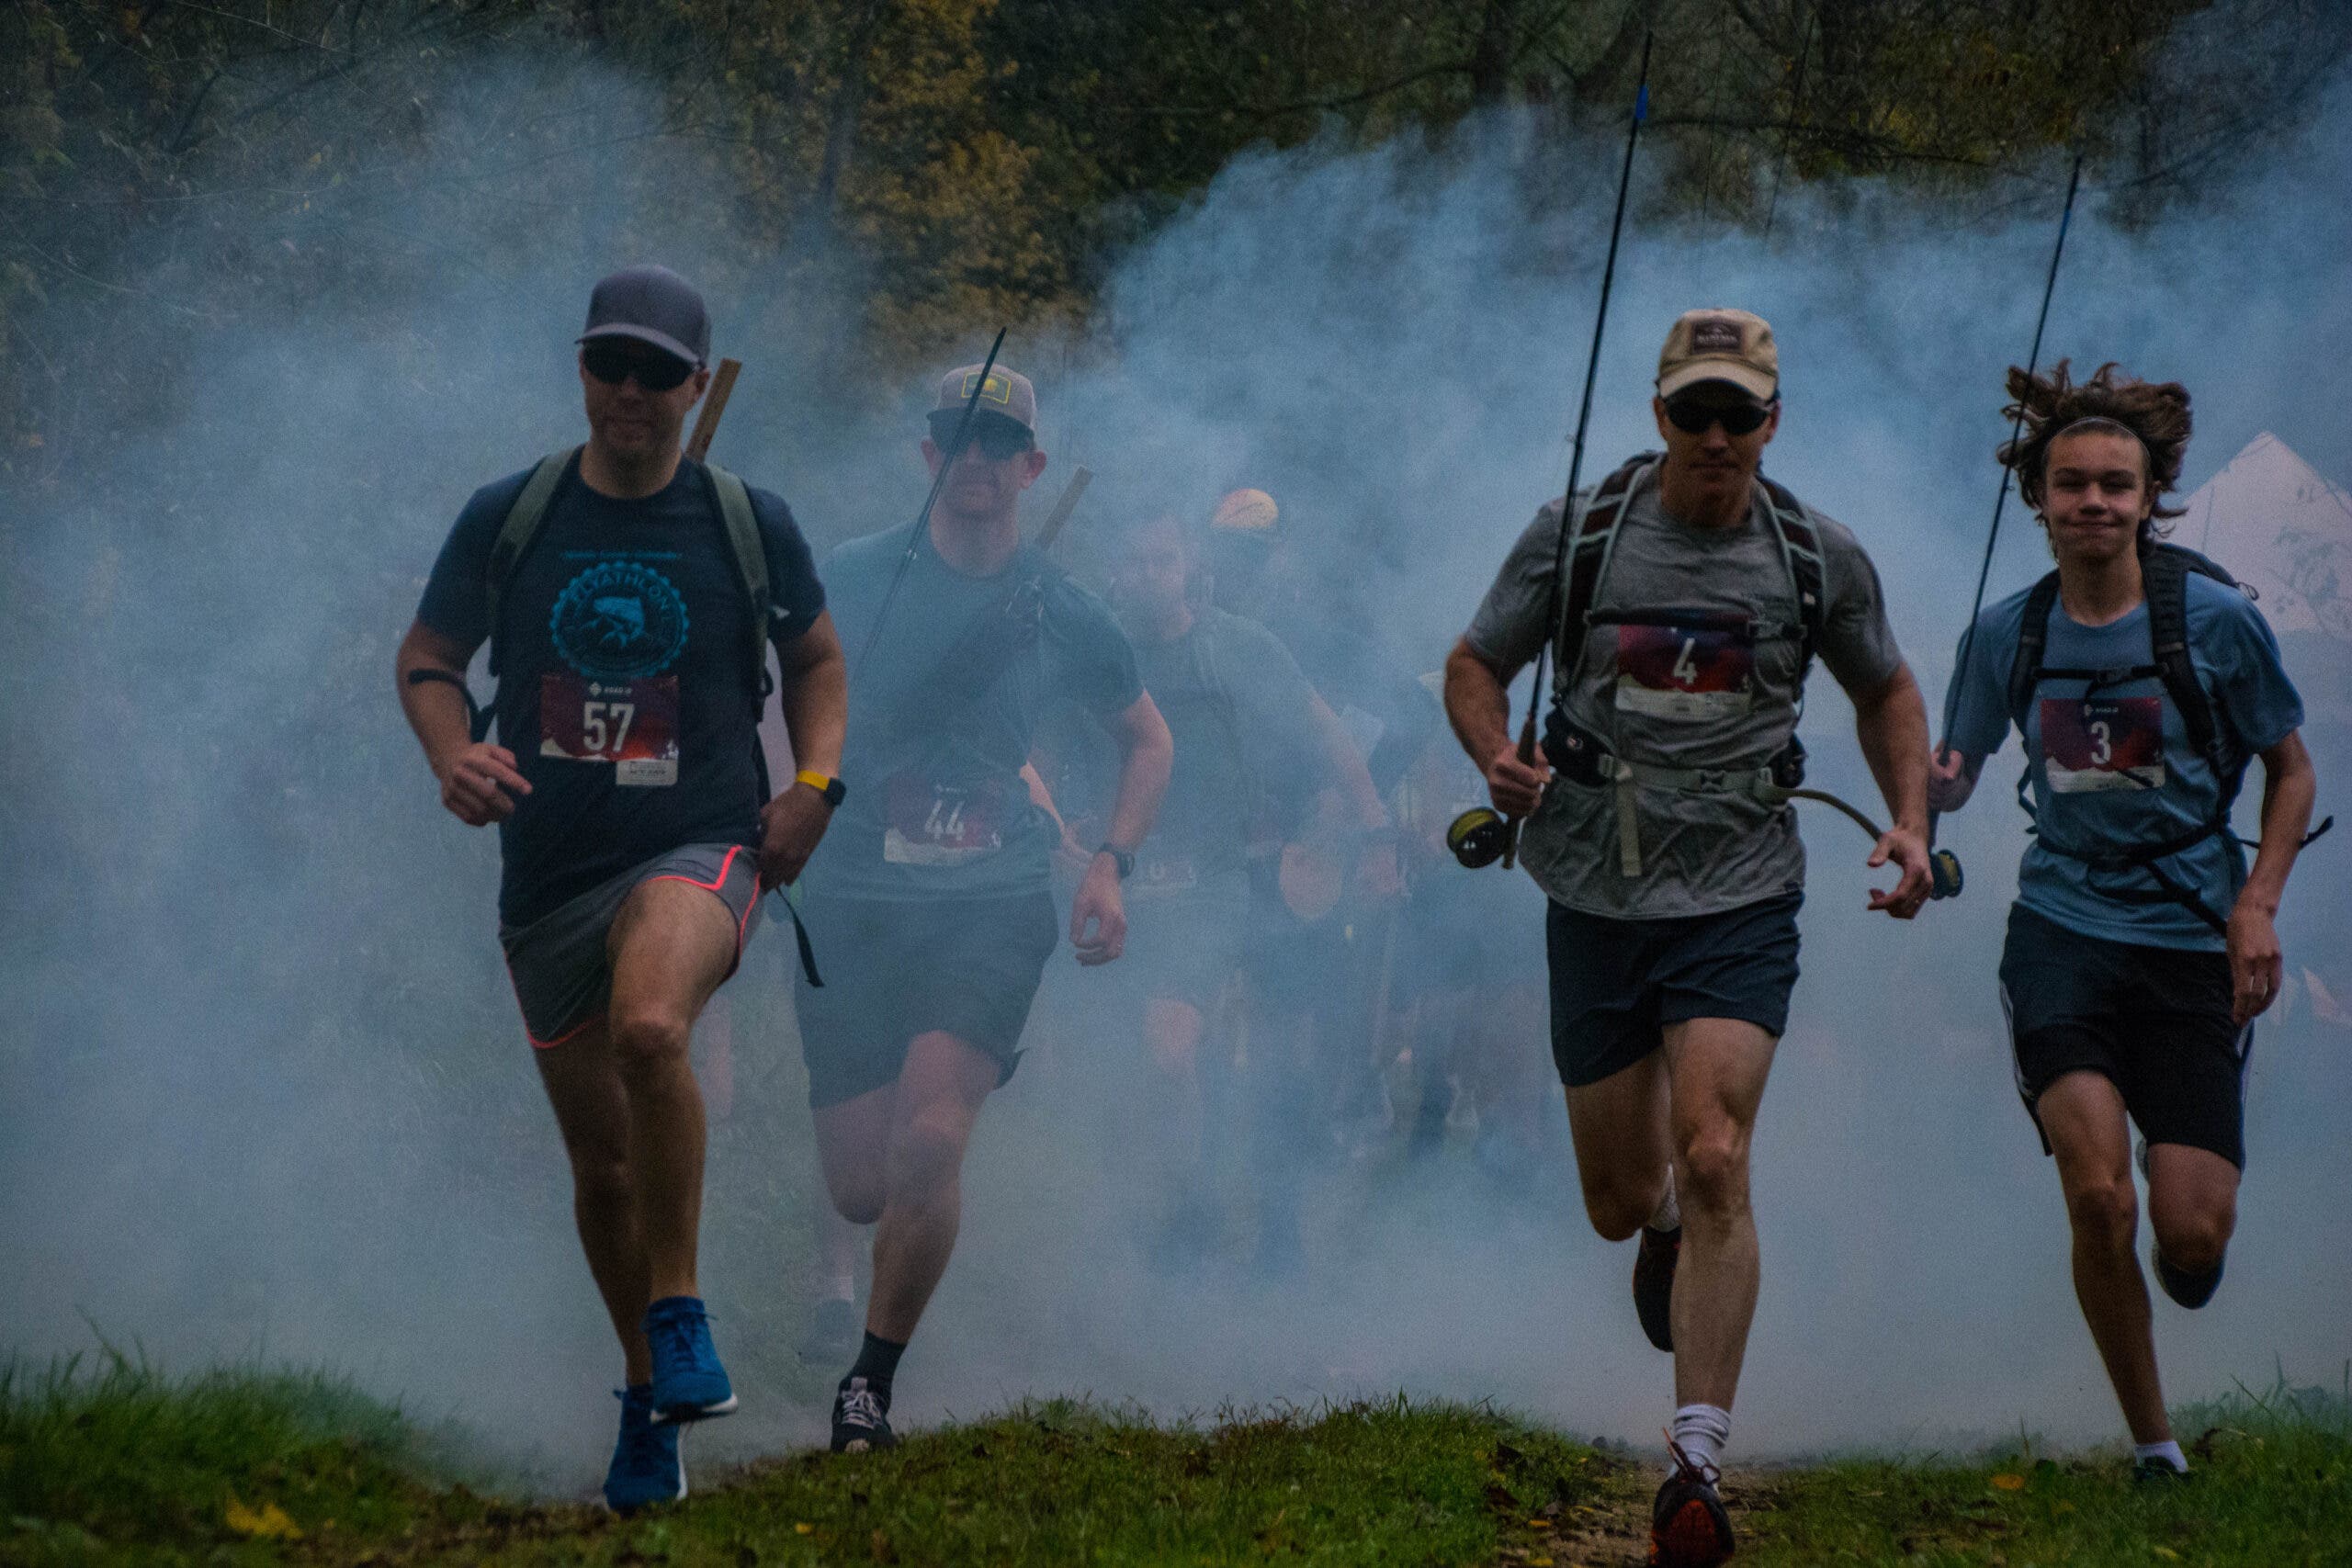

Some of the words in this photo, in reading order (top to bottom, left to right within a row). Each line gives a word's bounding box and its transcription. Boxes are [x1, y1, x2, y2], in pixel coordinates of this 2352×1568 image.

[1672, 637, 1698, 684] 4
[582, 701, 636, 752] 57
[2090, 721, 2111, 764] 3
[924, 799, 967, 841] 44
